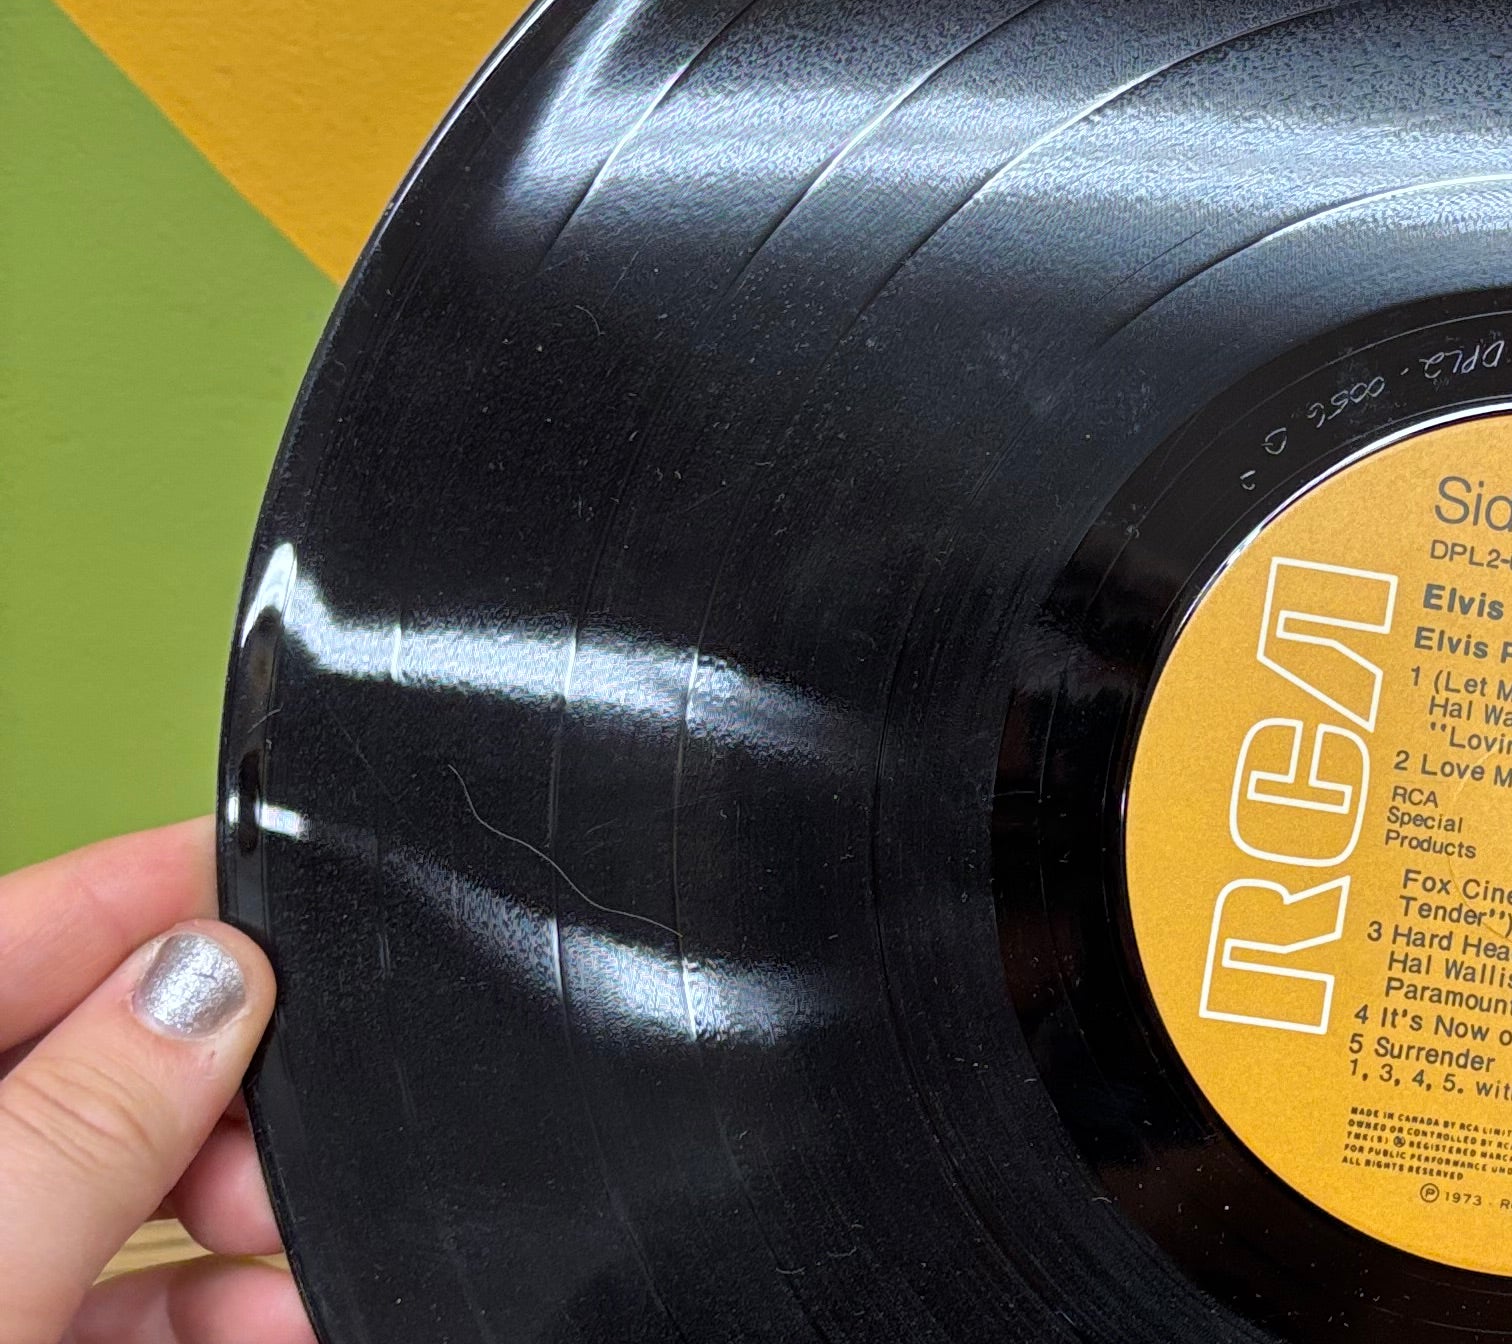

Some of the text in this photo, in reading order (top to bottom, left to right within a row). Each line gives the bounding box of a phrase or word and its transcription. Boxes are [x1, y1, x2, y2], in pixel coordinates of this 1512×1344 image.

[1422, 582, 1505, 621] Elvis
[1413, 625, 1489, 660] Elvis
[1410, 665, 1421, 687] 1
[1433, 669, 1488, 698] (Let
[1428, 695, 1474, 721] Hal
[1393, 749, 1410, 772] 2
[1420, 753, 1486, 782] Love
[1198, 556, 1398, 1035] RCA
[1391, 784, 1439, 809] RCA
[1386, 805, 1464, 834] Special
[1384, 828, 1477, 860] Products
[1399, 868, 1452, 897] Fox
[1366, 920, 1383, 943] 3
[1391, 923, 1454, 952] Hard
[1387, 950, 1433, 976] Hal
[1353, 1003, 1370, 1025] 4
[1380, 1006, 1424, 1032] It's
[1433, 1014, 1491, 1042] Now
[1348, 1032, 1496, 1073] 5 Surrender
[1349, 1058, 1369, 1082] 1,
[1378, 1062, 1401, 1088] 3,
[1411, 1068, 1433, 1092] 4,
[1445, 1191, 1482, 1207] 1973
